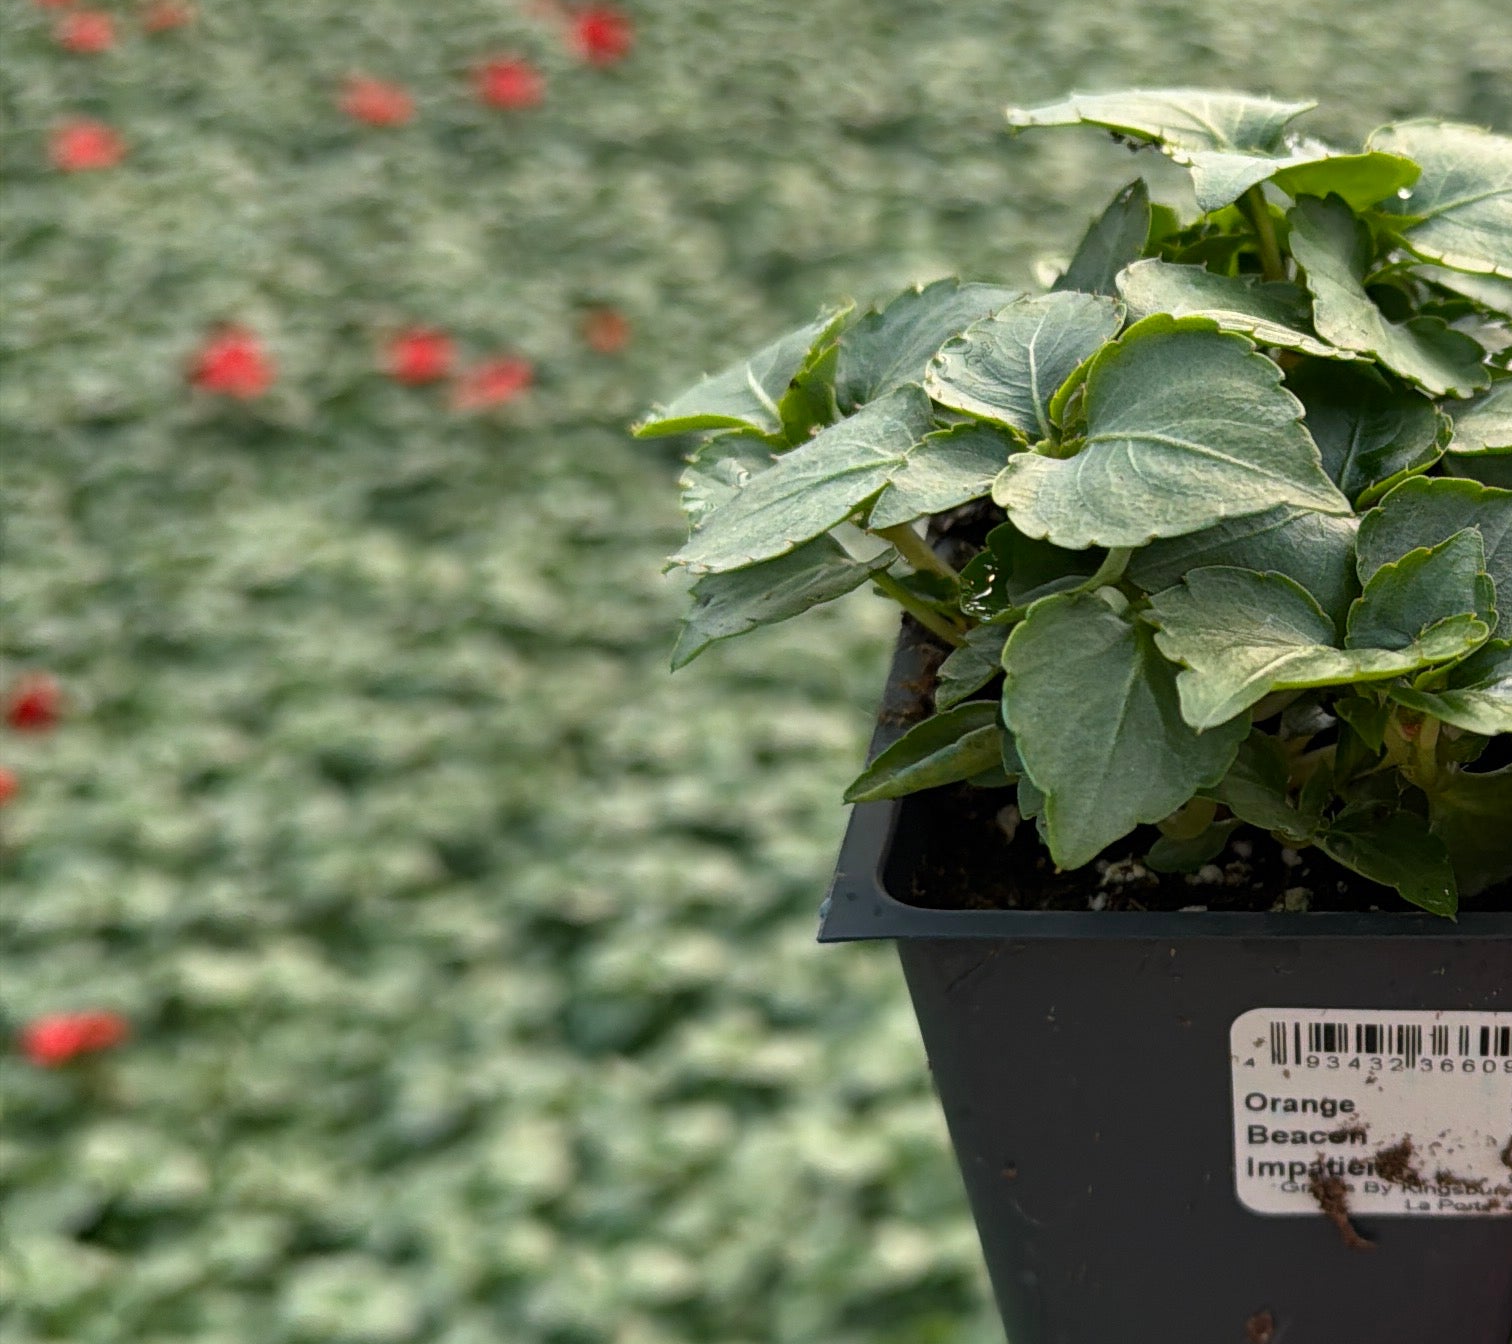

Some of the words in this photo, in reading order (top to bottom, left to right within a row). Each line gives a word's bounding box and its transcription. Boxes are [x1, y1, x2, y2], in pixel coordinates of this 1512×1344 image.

[1306, 1055, 1404, 1073] 93432
[1244, 1091, 1356, 1118] Orange
[1247, 1124, 1368, 1145] Beacon
[1364, 1180, 1392, 1196] By
